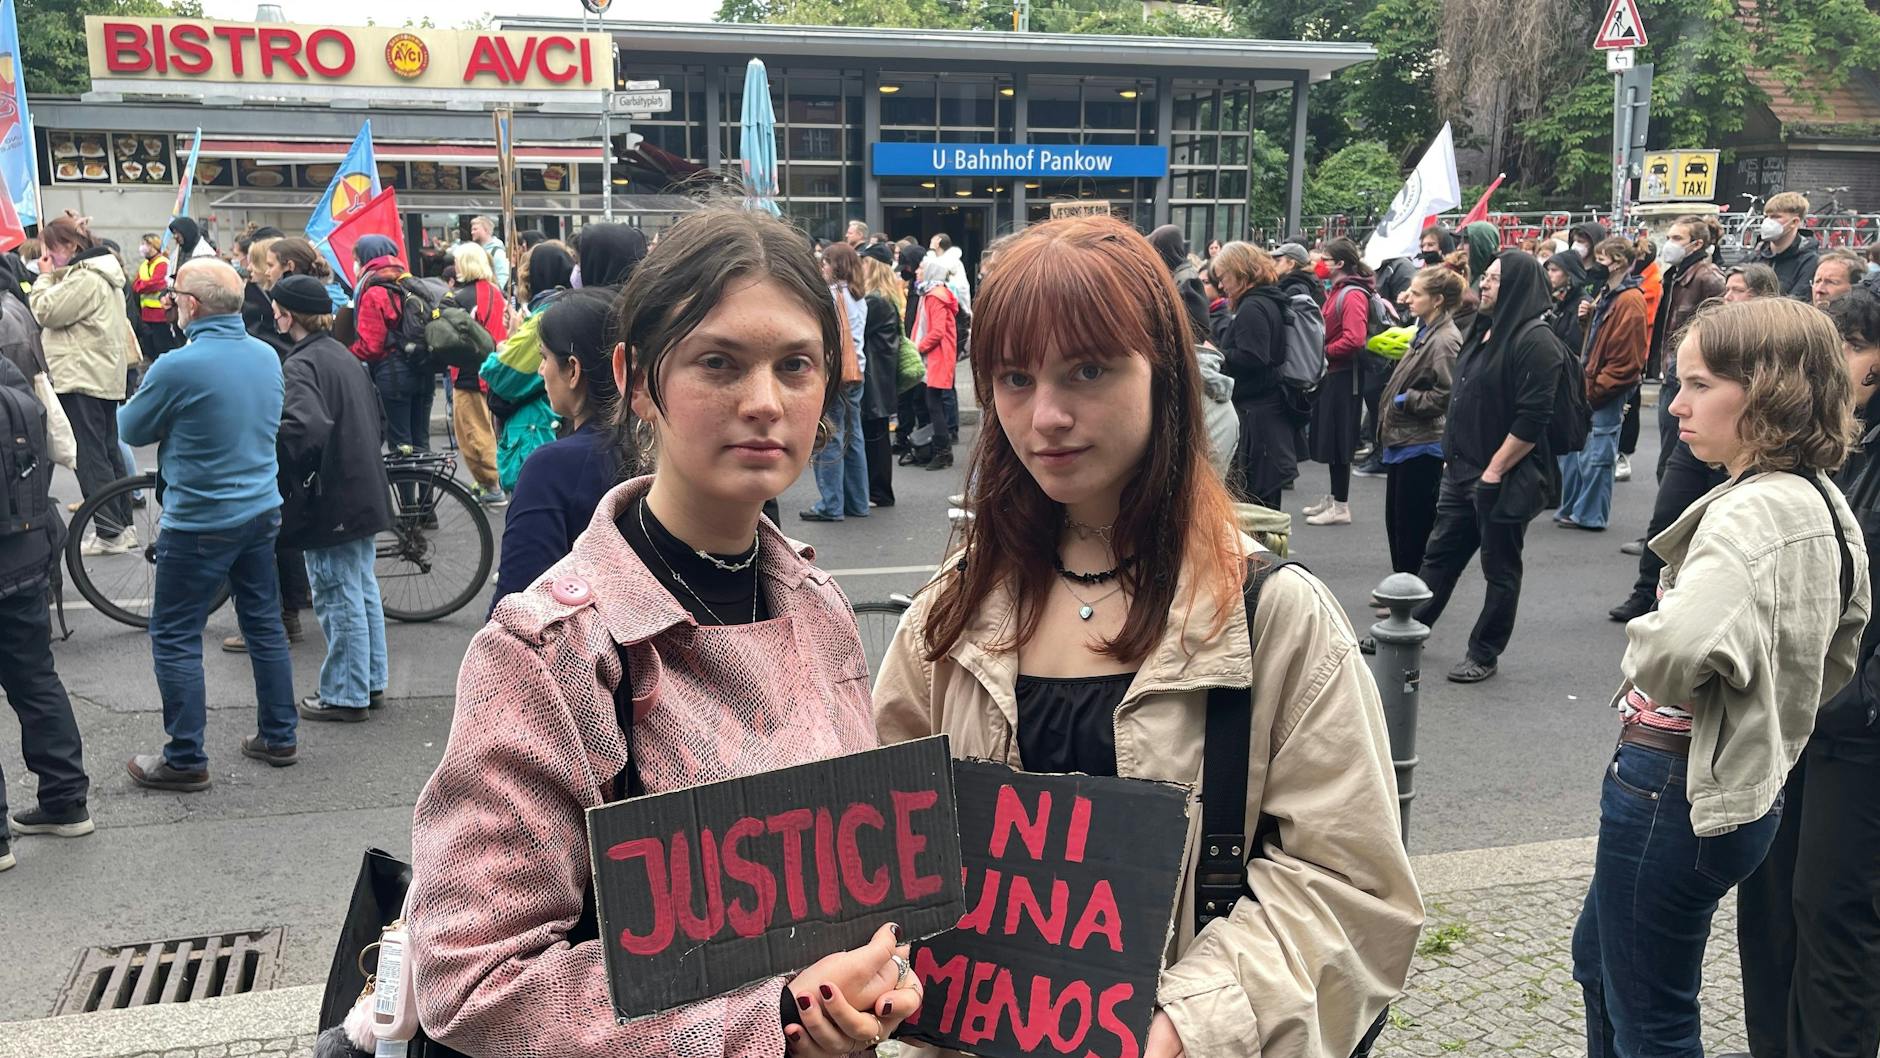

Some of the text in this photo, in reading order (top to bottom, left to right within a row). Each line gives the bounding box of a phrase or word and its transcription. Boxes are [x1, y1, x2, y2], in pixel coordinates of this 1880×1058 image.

[103, 22, 593, 84] BISTRO AVCI
[1040, 149, 1113, 171] Pankow
[1682, 180, 1707, 195] TAXI
[988, 784, 1092, 863] NI
[605, 789, 944, 956] JUSTICE
[904, 946, 1140, 1058] MENOS
